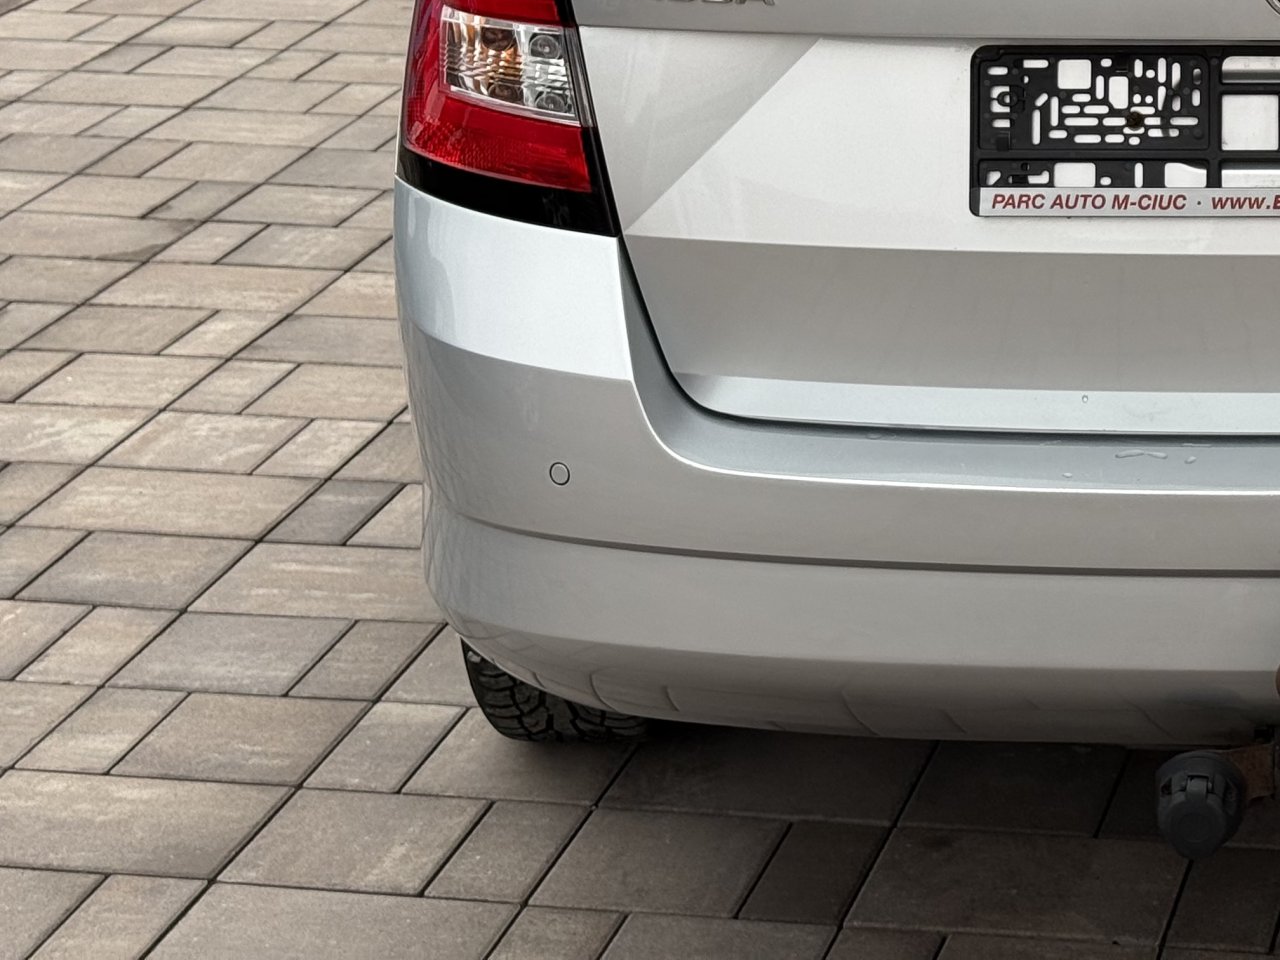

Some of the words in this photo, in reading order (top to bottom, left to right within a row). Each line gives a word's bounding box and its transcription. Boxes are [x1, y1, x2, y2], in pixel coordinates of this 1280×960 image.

[991, 193, 1046, 210] PARC
[1050, 193, 1107, 210] AUTO
[1111, 193, 1187, 211] M-CIUC
